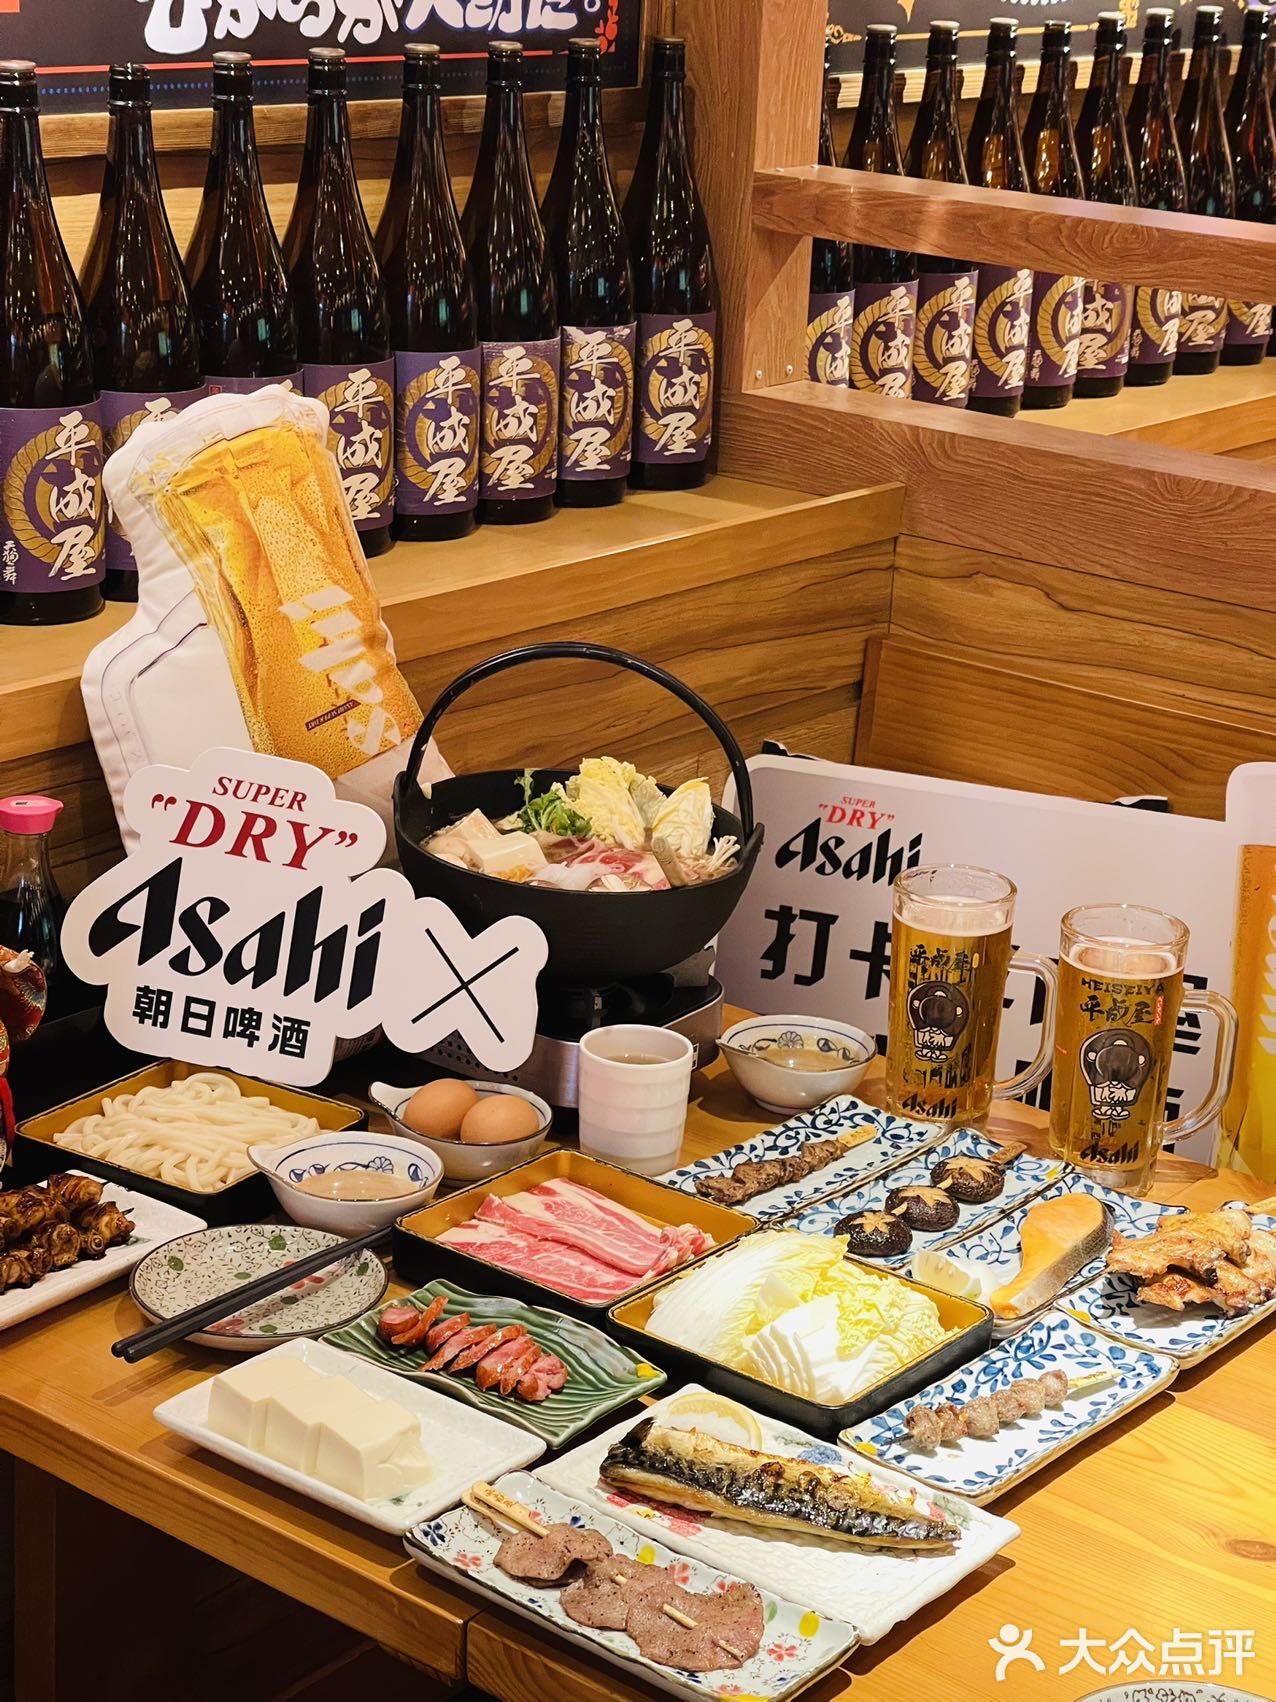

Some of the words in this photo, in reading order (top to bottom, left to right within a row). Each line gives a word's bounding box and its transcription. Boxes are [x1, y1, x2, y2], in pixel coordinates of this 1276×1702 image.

[826, 295, 854, 388] 平成
[936, 277, 976, 402] 平成屋
[1078, 279, 1116, 370] 成屋
[423, 355, 472, 506] 平成屋
[487, 345, 541, 491] 平成屋
[566, 330, 619, 472] 平成屋
[654, 318, 704, 456] 平成屋
[334, 368, 385, 520] 平成屋
[45, 410, 97, 581] 平成屋
[211, 776, 307, 812] SUPER
[842, 796, 876, 808] SUPER
[775, 817, 923, 886] Asahi
[88, 856, 387, 1010] Asahi
[132, 984, 312, 1060] 朝日啤酒
[1081, 977, 1165, 995] HEISEIYA
[902, 1092, 958, 1119] Asahi
[1080, 1140, 1140, 1164] Asahi
